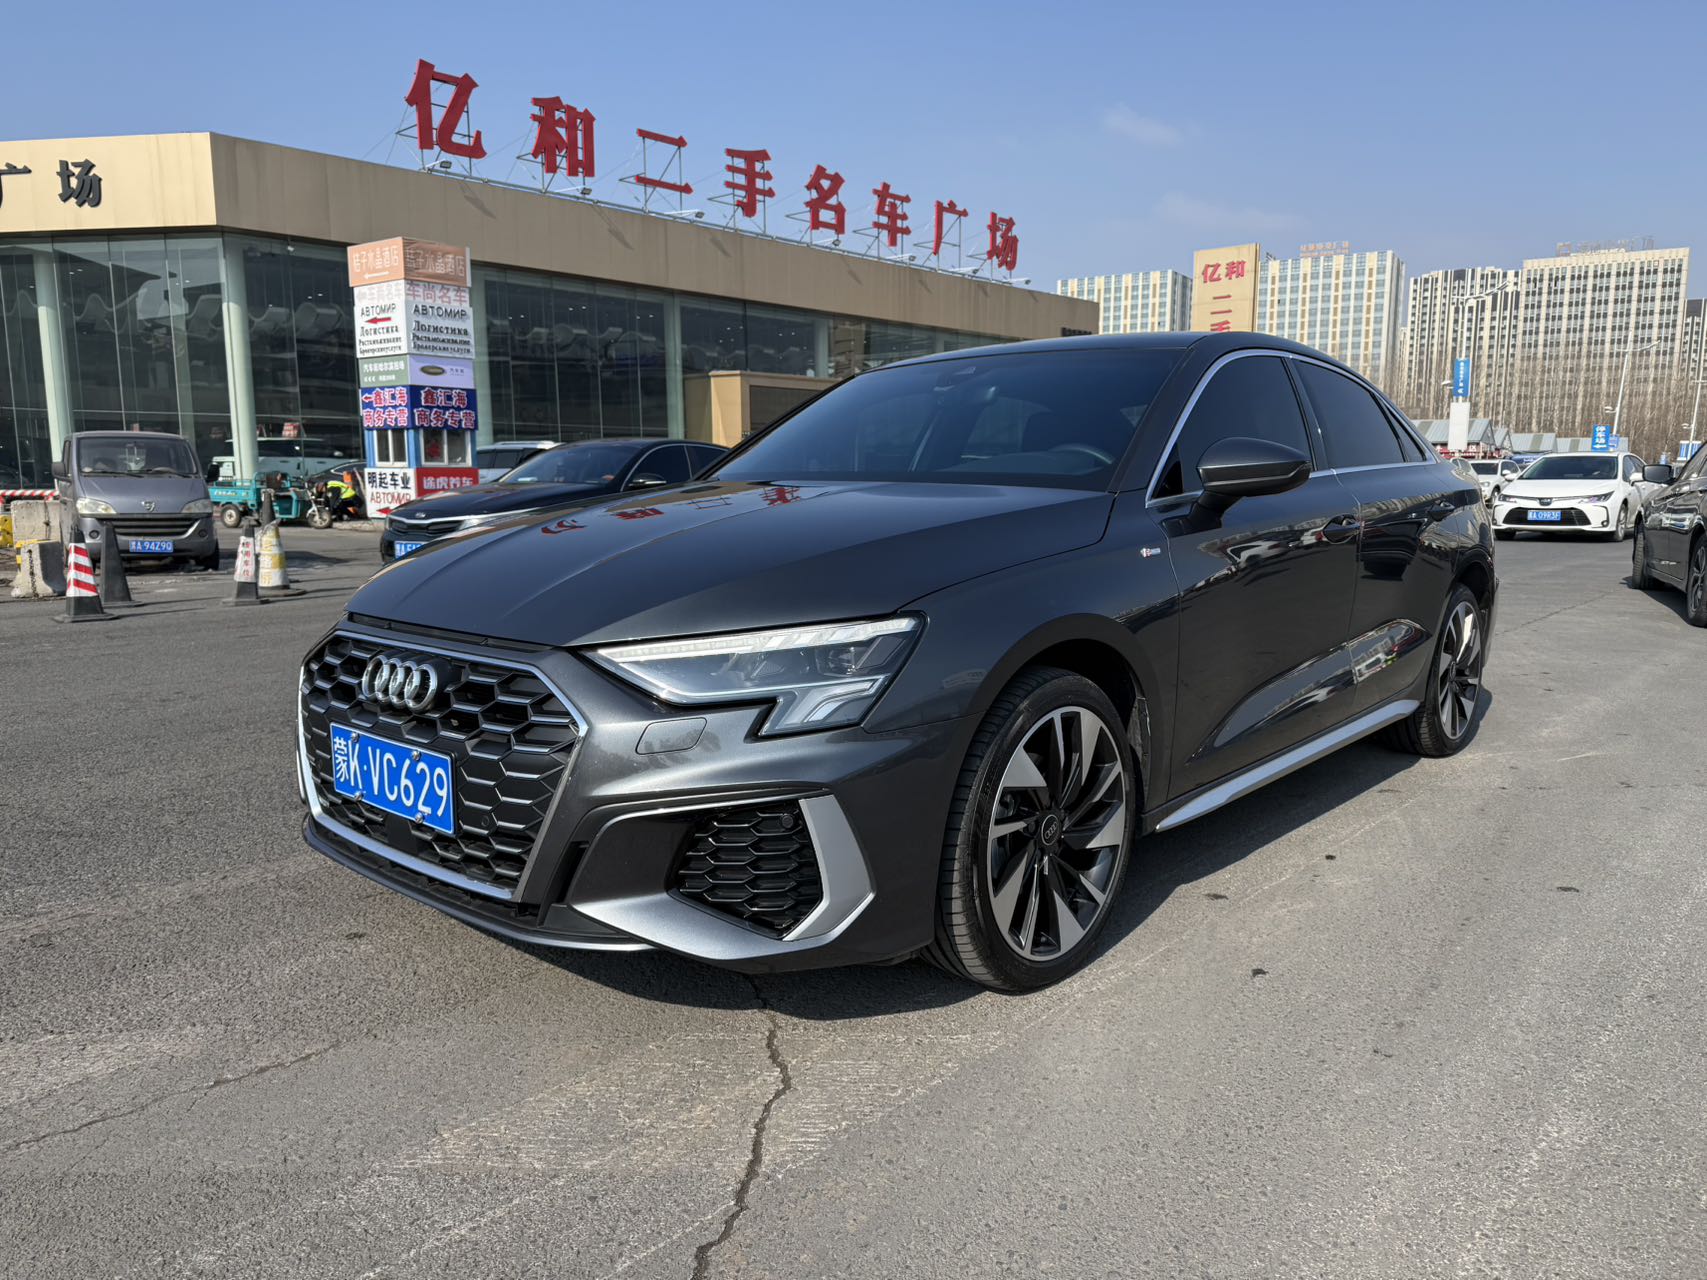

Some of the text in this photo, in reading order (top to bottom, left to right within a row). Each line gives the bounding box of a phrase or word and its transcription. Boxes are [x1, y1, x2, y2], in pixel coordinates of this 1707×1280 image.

[405, 59, 1019, 271] 亿和二手名车广场
[1201, 259, 1246, 284] 亿和
[360, 303, 397, 317] АВТОМИР
[413, 304, 467, 319] АВТОМИР
[360, 325, 399, 337] Логистика
[412, 320, 469, 336] Логистика
[373, 386, 407, 407] 鑫汇海
[421, 387, 467, 408] 鑫汇海
[363, 407, 408, 427] 商务专营
[414, 408, 475, 429] 商务专营
[367, 471, 411, 489] 明起车业
[370, 491, 411, 504] АВТОМИР
